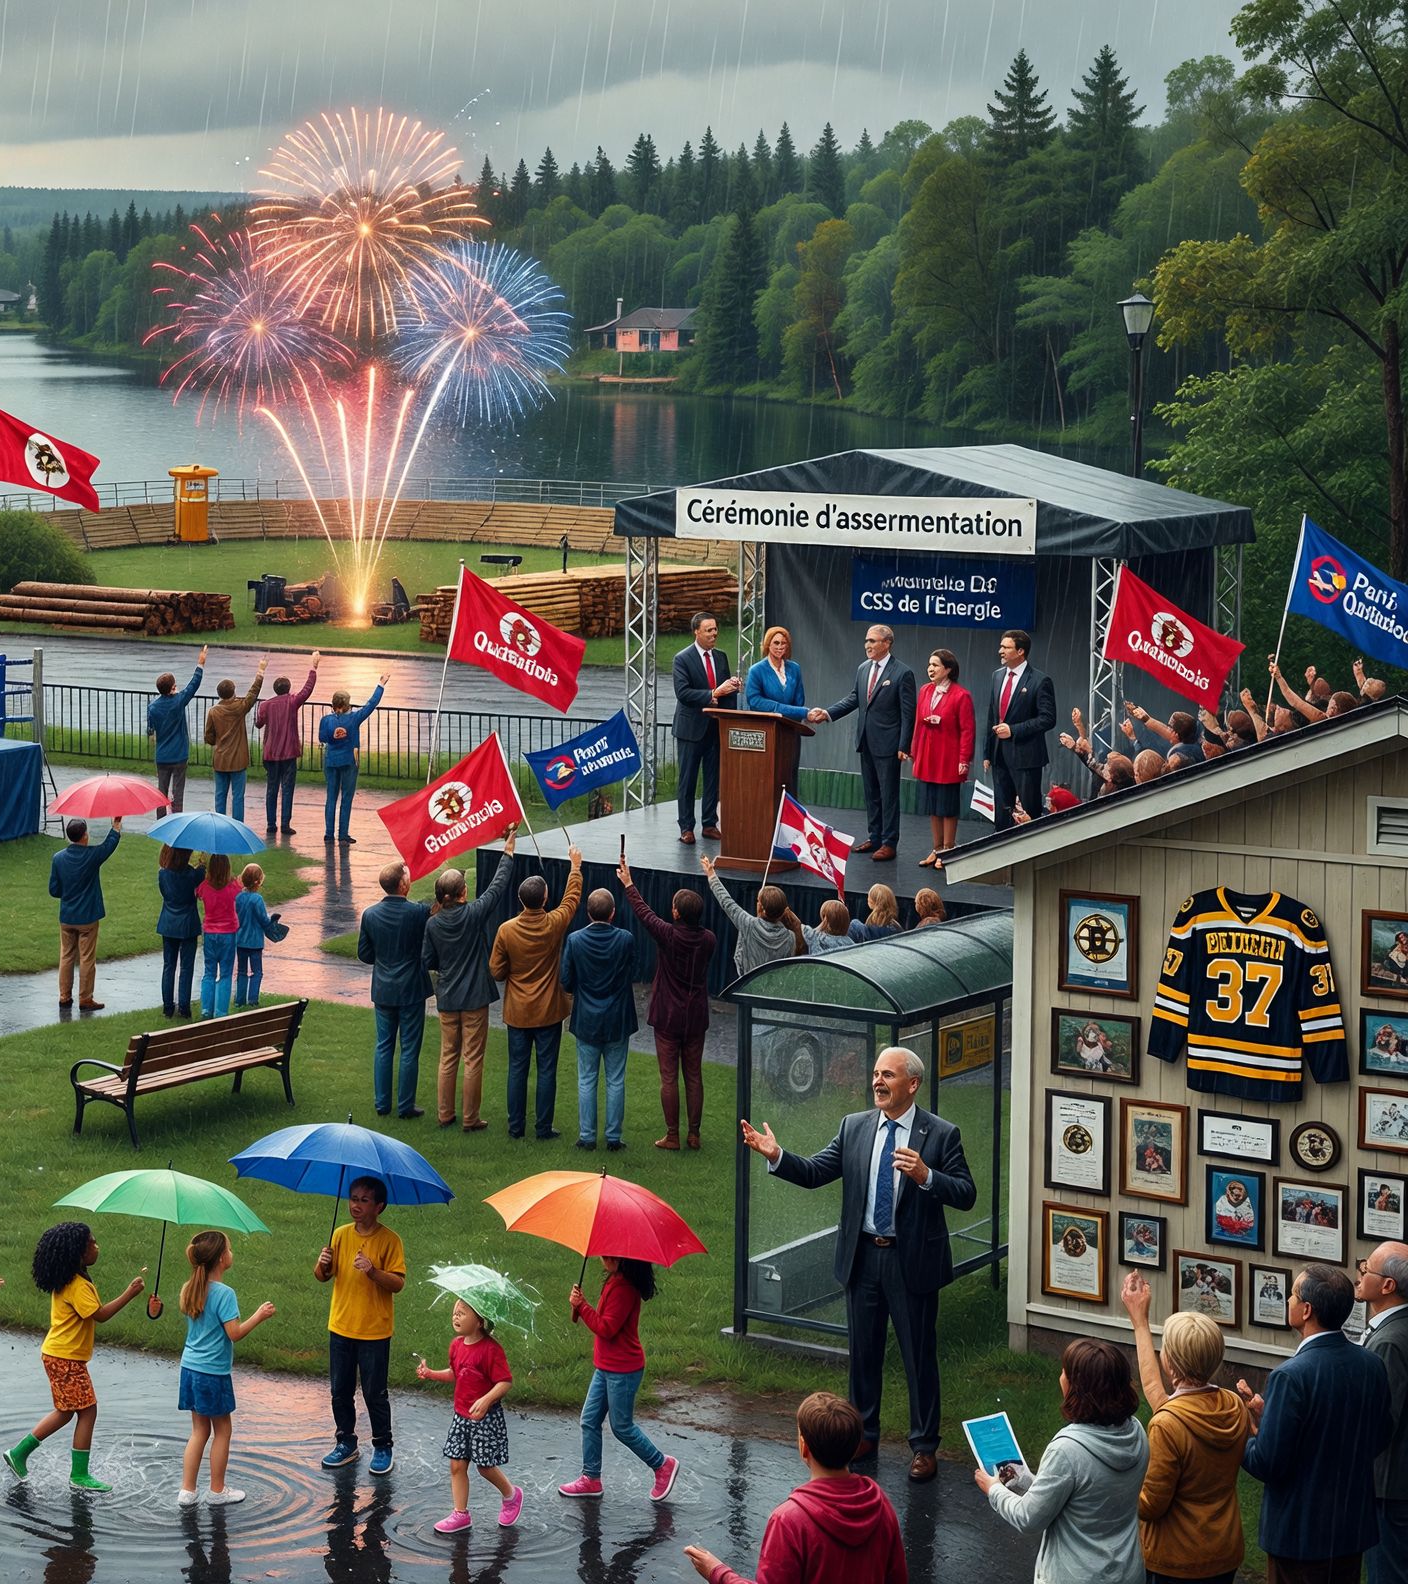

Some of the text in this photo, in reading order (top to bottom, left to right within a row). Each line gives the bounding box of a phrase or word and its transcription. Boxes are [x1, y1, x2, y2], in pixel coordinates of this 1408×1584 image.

[687, 499, 1023, 538] Cérémonie d'assermentation
[860, 592, 894, 611] CSS
[898, 594, 920, 613] de
[1205, 958, 1283, 1028] 37
